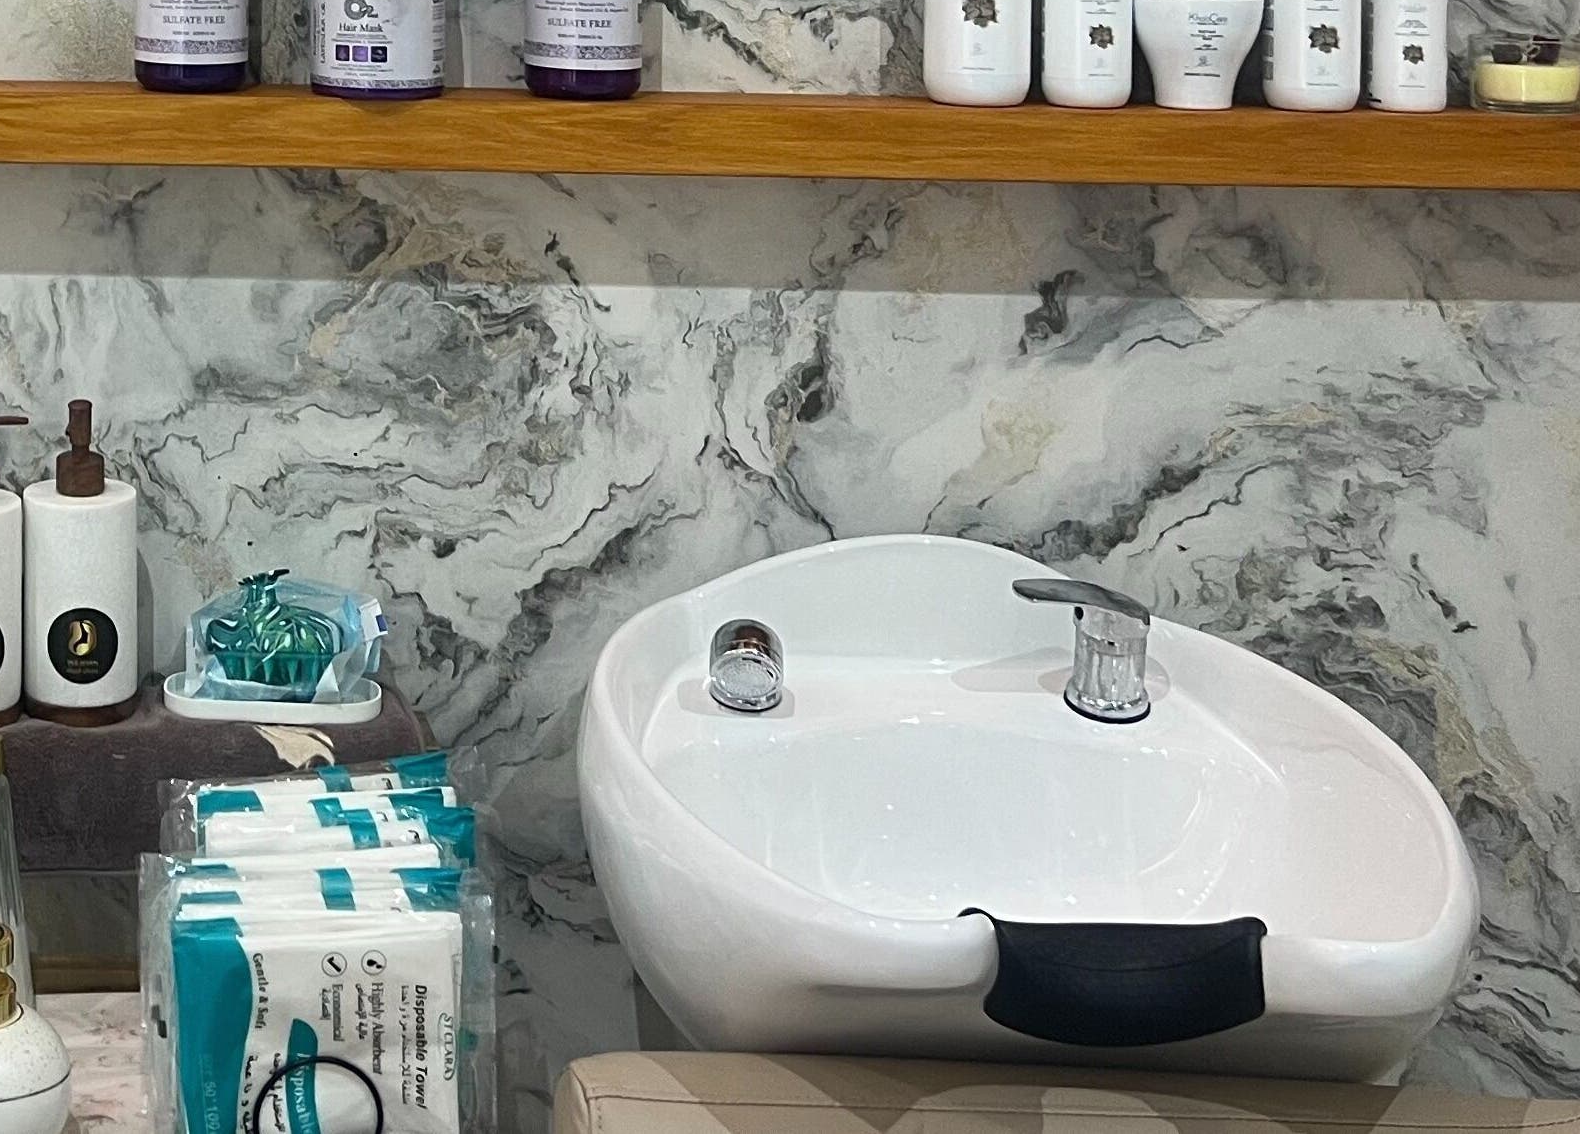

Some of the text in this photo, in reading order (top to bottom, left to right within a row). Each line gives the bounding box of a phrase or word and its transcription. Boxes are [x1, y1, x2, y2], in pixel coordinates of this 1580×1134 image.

[204, 15, 226, 25] FREE
[339, 22, 384, 33] Hair Mask
[589, 19, 612, 28] FREE
[252, 952, 269, 1030] Gentle & Soft
[368, 982, 385, 1021] Highly
[413, 984, 428, 1110] Disposable Towel
[443, 1032, 454, 1077] CLARA
